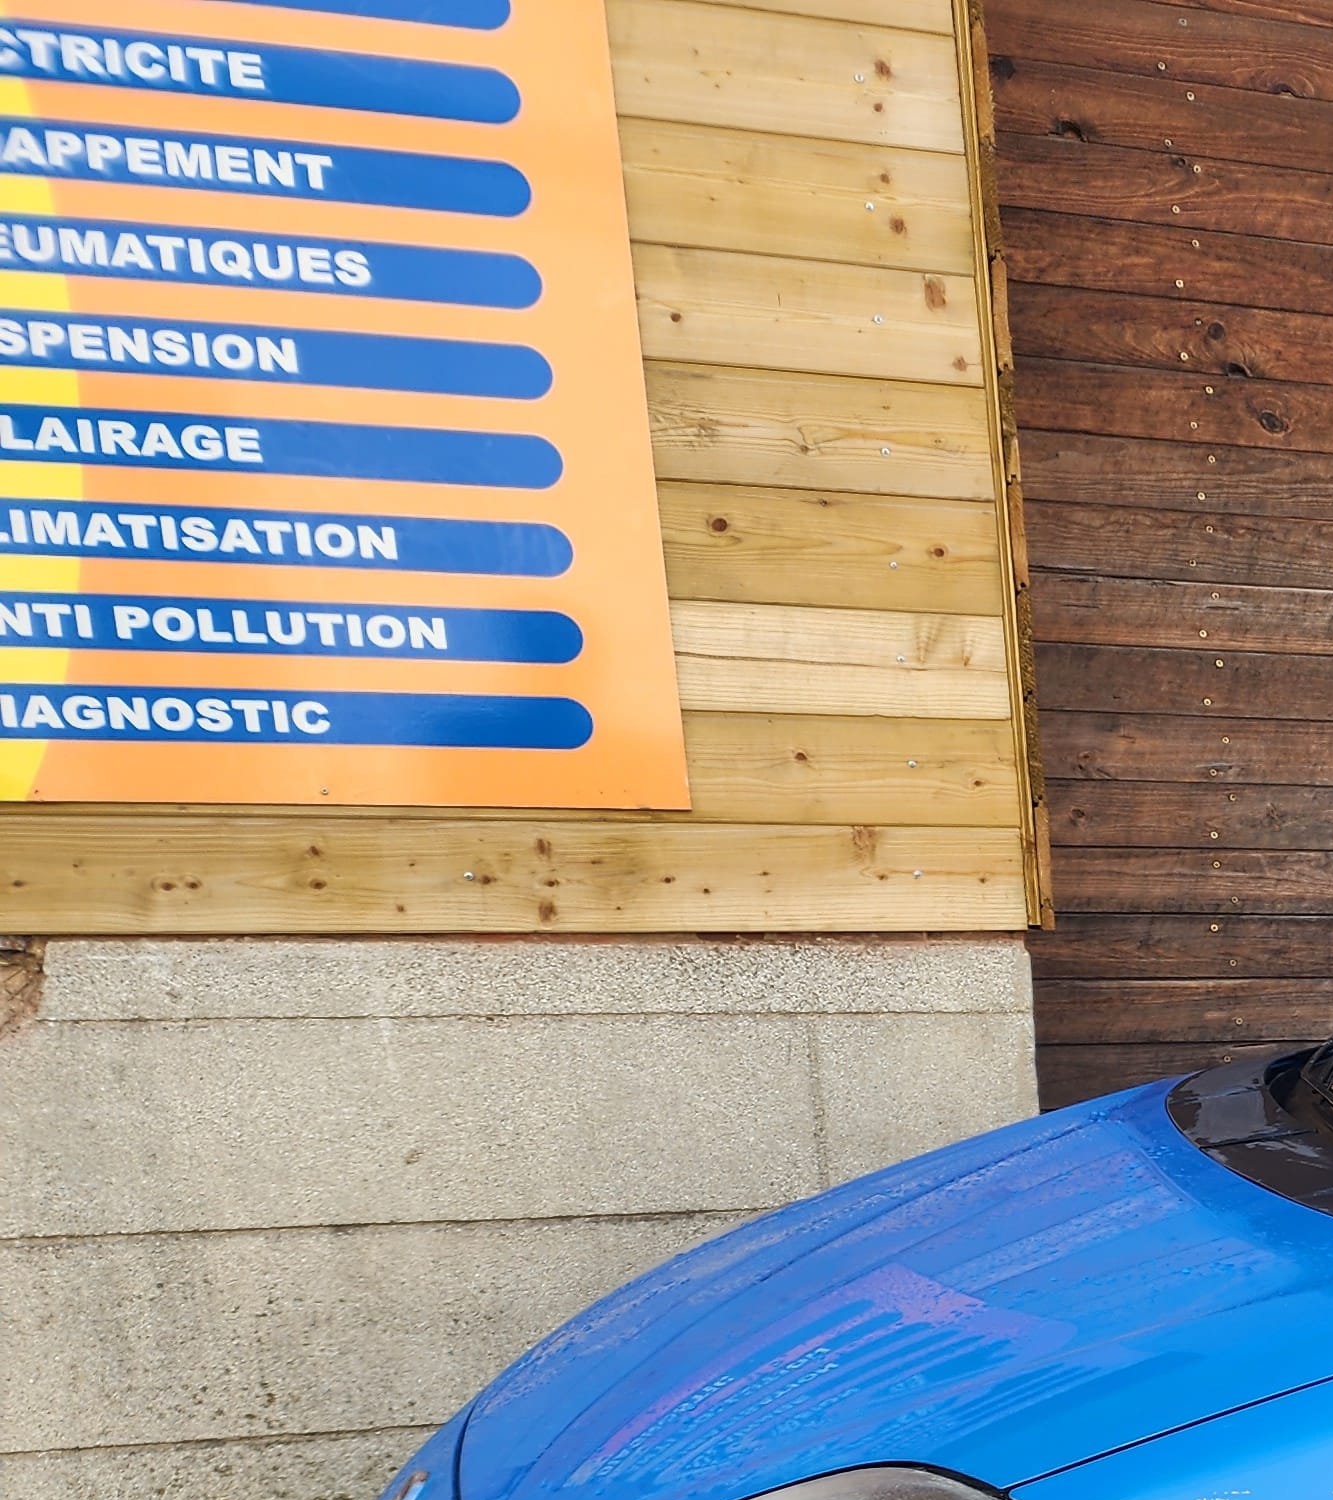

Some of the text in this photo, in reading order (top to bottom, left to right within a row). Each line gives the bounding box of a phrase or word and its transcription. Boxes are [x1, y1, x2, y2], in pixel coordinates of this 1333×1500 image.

[1, 127, 333, 191] APPEMENT
[0, 319, 299, 375] SPENSION
[0, 414, 264, 463] LAIRAGE
[0, 602, 448, 650] NTI POLLUTION
[0, 693, 330, 734] IAGNOSTIC
